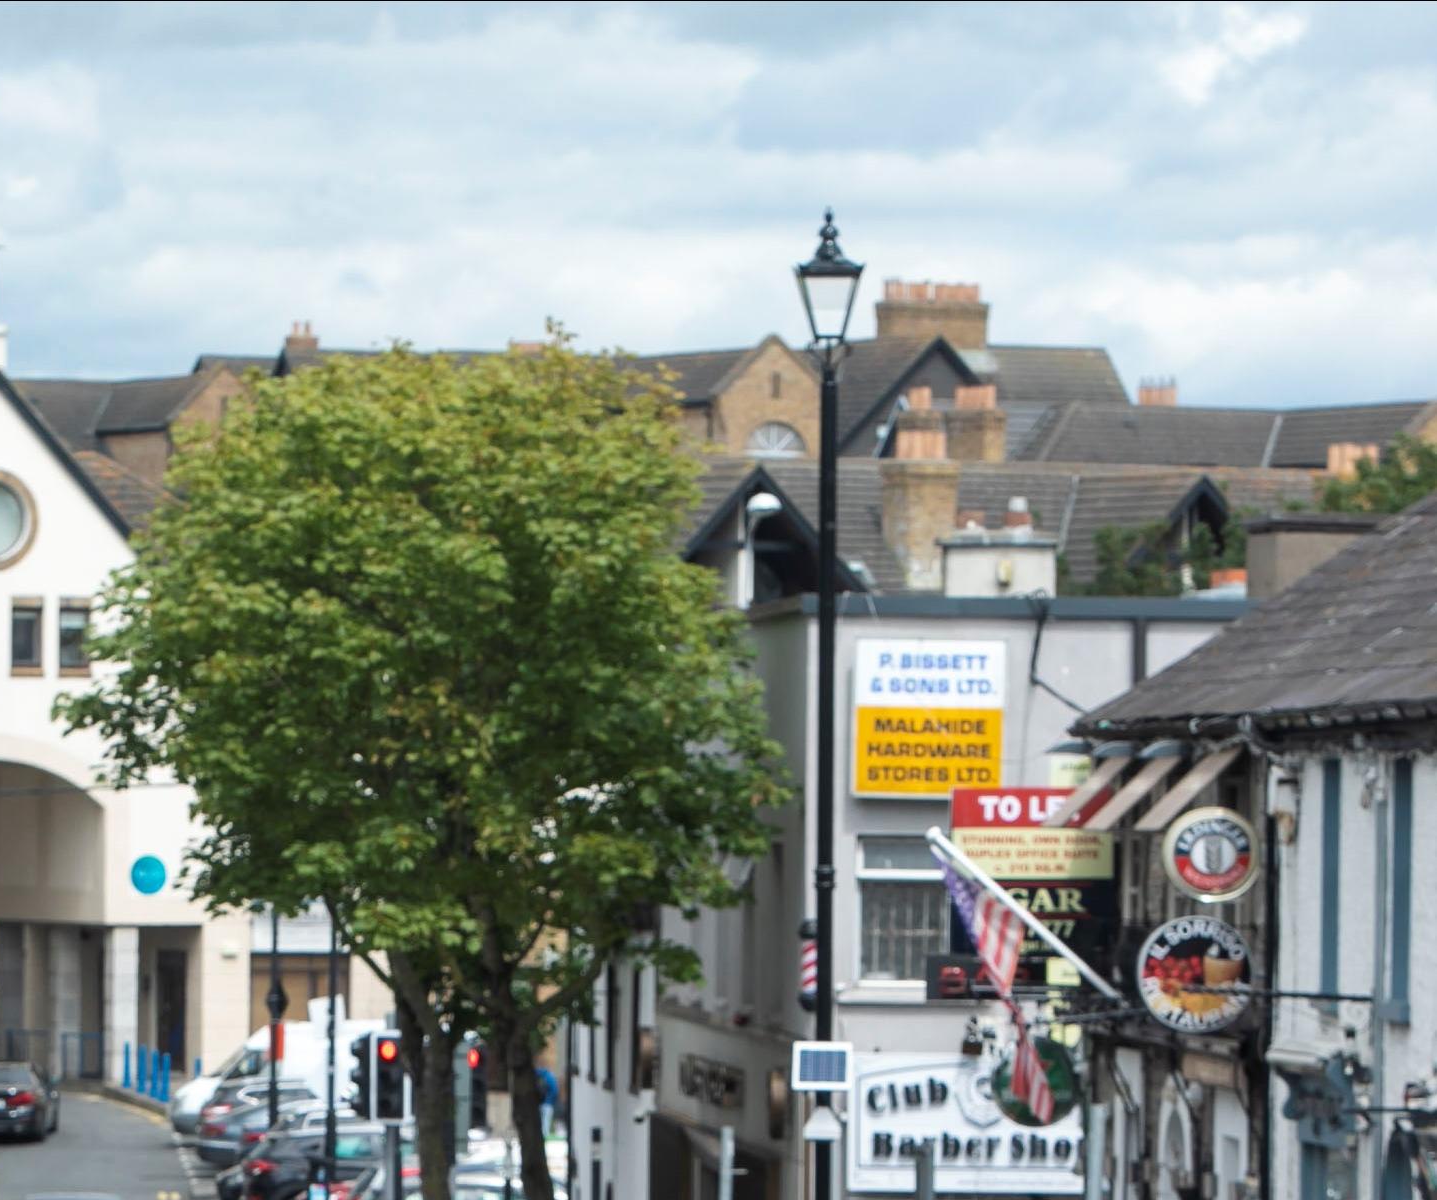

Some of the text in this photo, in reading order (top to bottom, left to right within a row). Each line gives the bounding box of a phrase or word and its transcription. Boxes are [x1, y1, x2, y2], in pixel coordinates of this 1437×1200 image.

[900, 653, 990, 671] BISSETT
[870, 677, 998, 695] & SONS LTD.
[873, 718, 987, 735] MALAHIDE
[866, 742, 993, 759] HARDWARE
[866, 766, 997, 783] STORES LTD.
[977, 795, 1080, 822] TO LE
[866, 1076, 949, 1112] Club
[871, 1131, 1001, 1161] Barber
